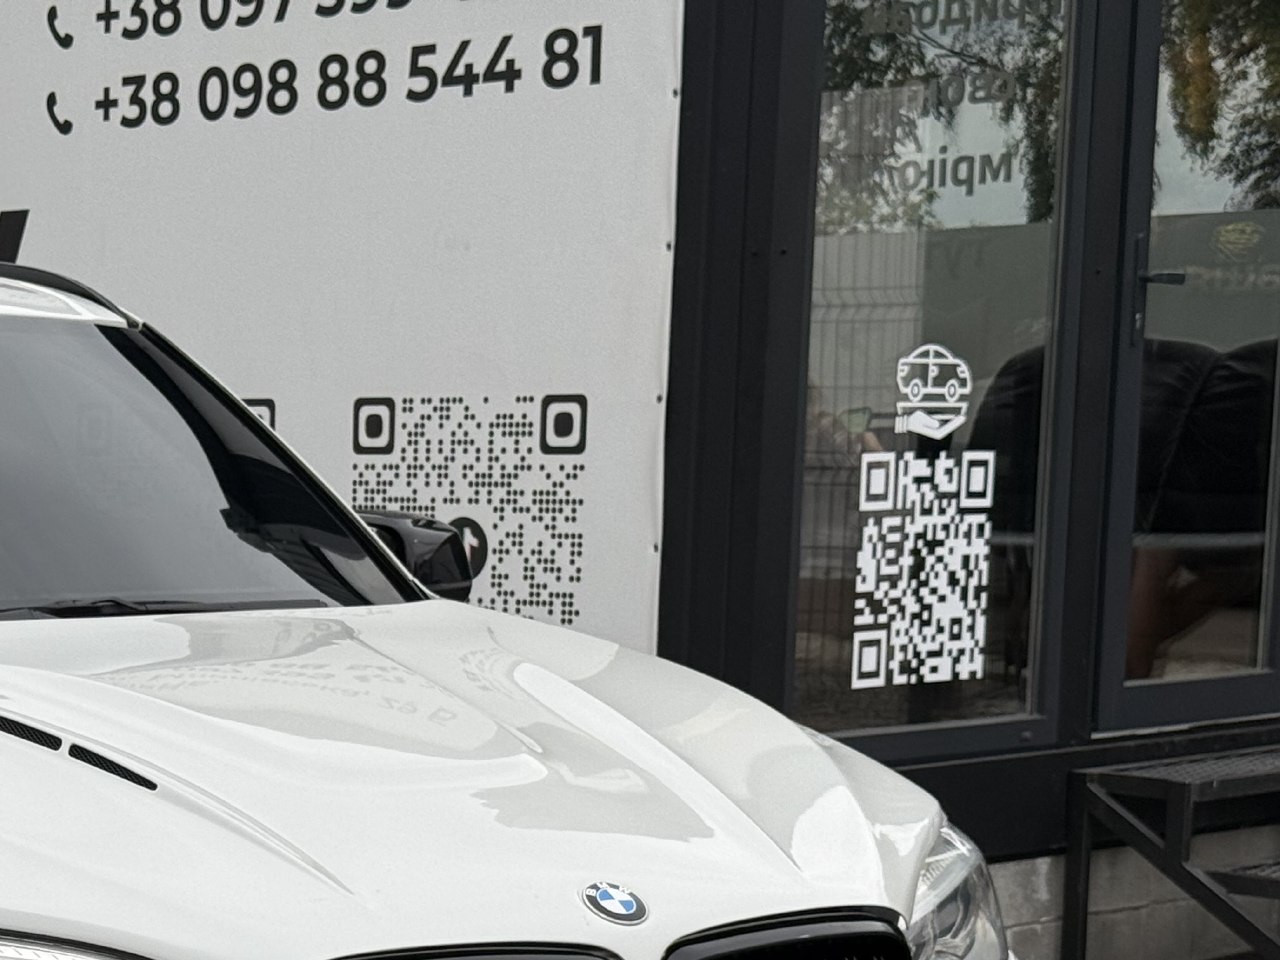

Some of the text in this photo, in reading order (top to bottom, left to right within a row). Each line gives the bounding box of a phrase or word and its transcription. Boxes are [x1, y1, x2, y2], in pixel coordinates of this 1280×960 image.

[94, 25, 604, 129] +38 098 88 544 81
